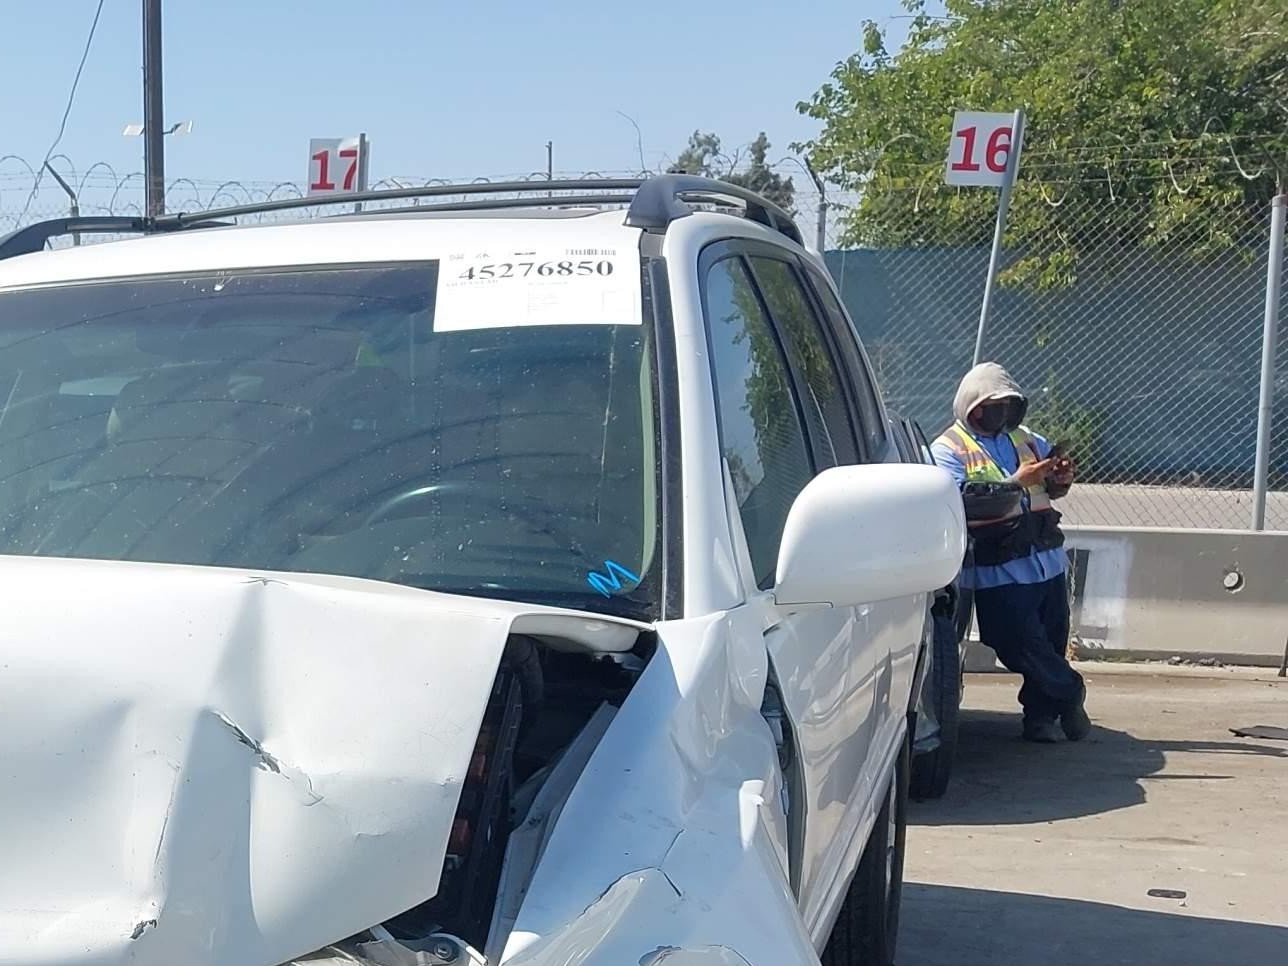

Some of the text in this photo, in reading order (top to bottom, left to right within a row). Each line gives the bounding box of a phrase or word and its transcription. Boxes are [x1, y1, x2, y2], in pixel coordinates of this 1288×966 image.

[311, 149, 358, 190] 17
[951, 126, 1013, 173] 16
[458, 260, 614, 280] 45276850
